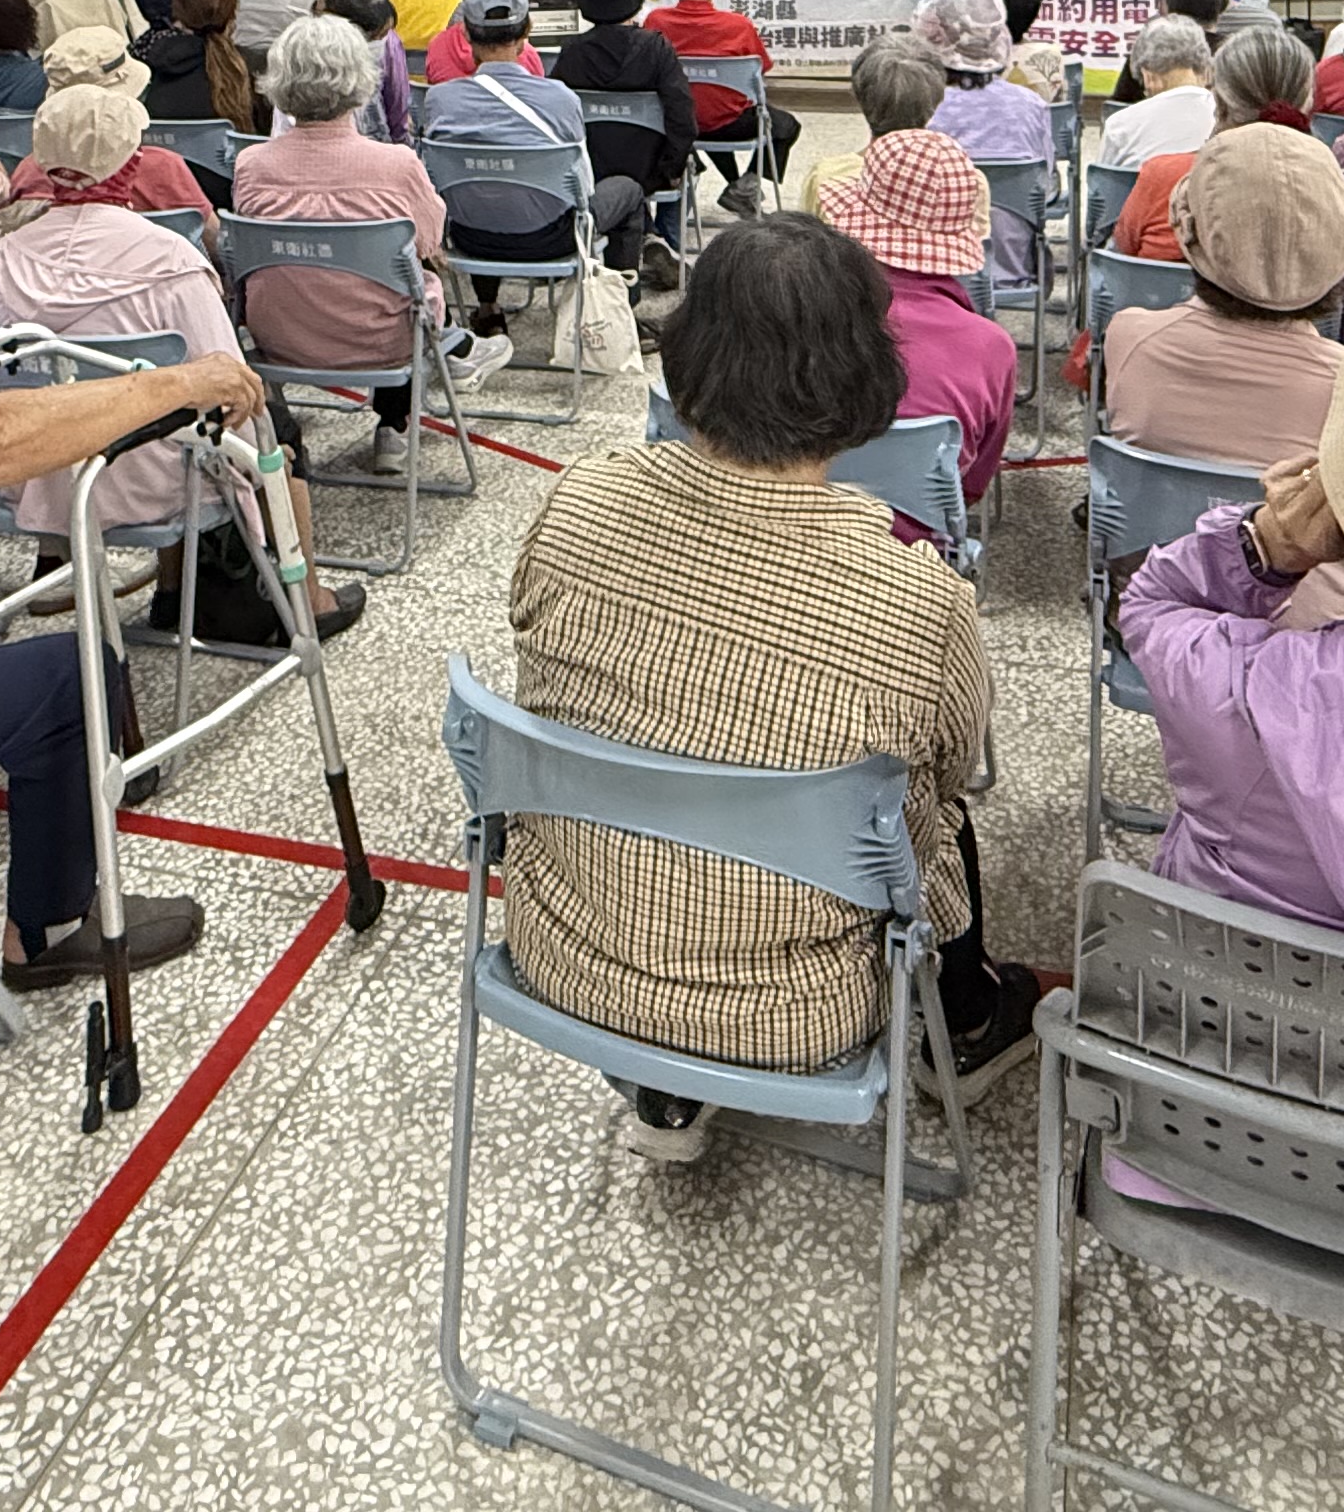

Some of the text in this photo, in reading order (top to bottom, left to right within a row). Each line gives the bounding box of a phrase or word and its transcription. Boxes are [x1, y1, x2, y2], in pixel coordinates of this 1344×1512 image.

[730, 0, 797, 20] 澎湖縣
[757, 24, 911, 48] 治理與推廣計
